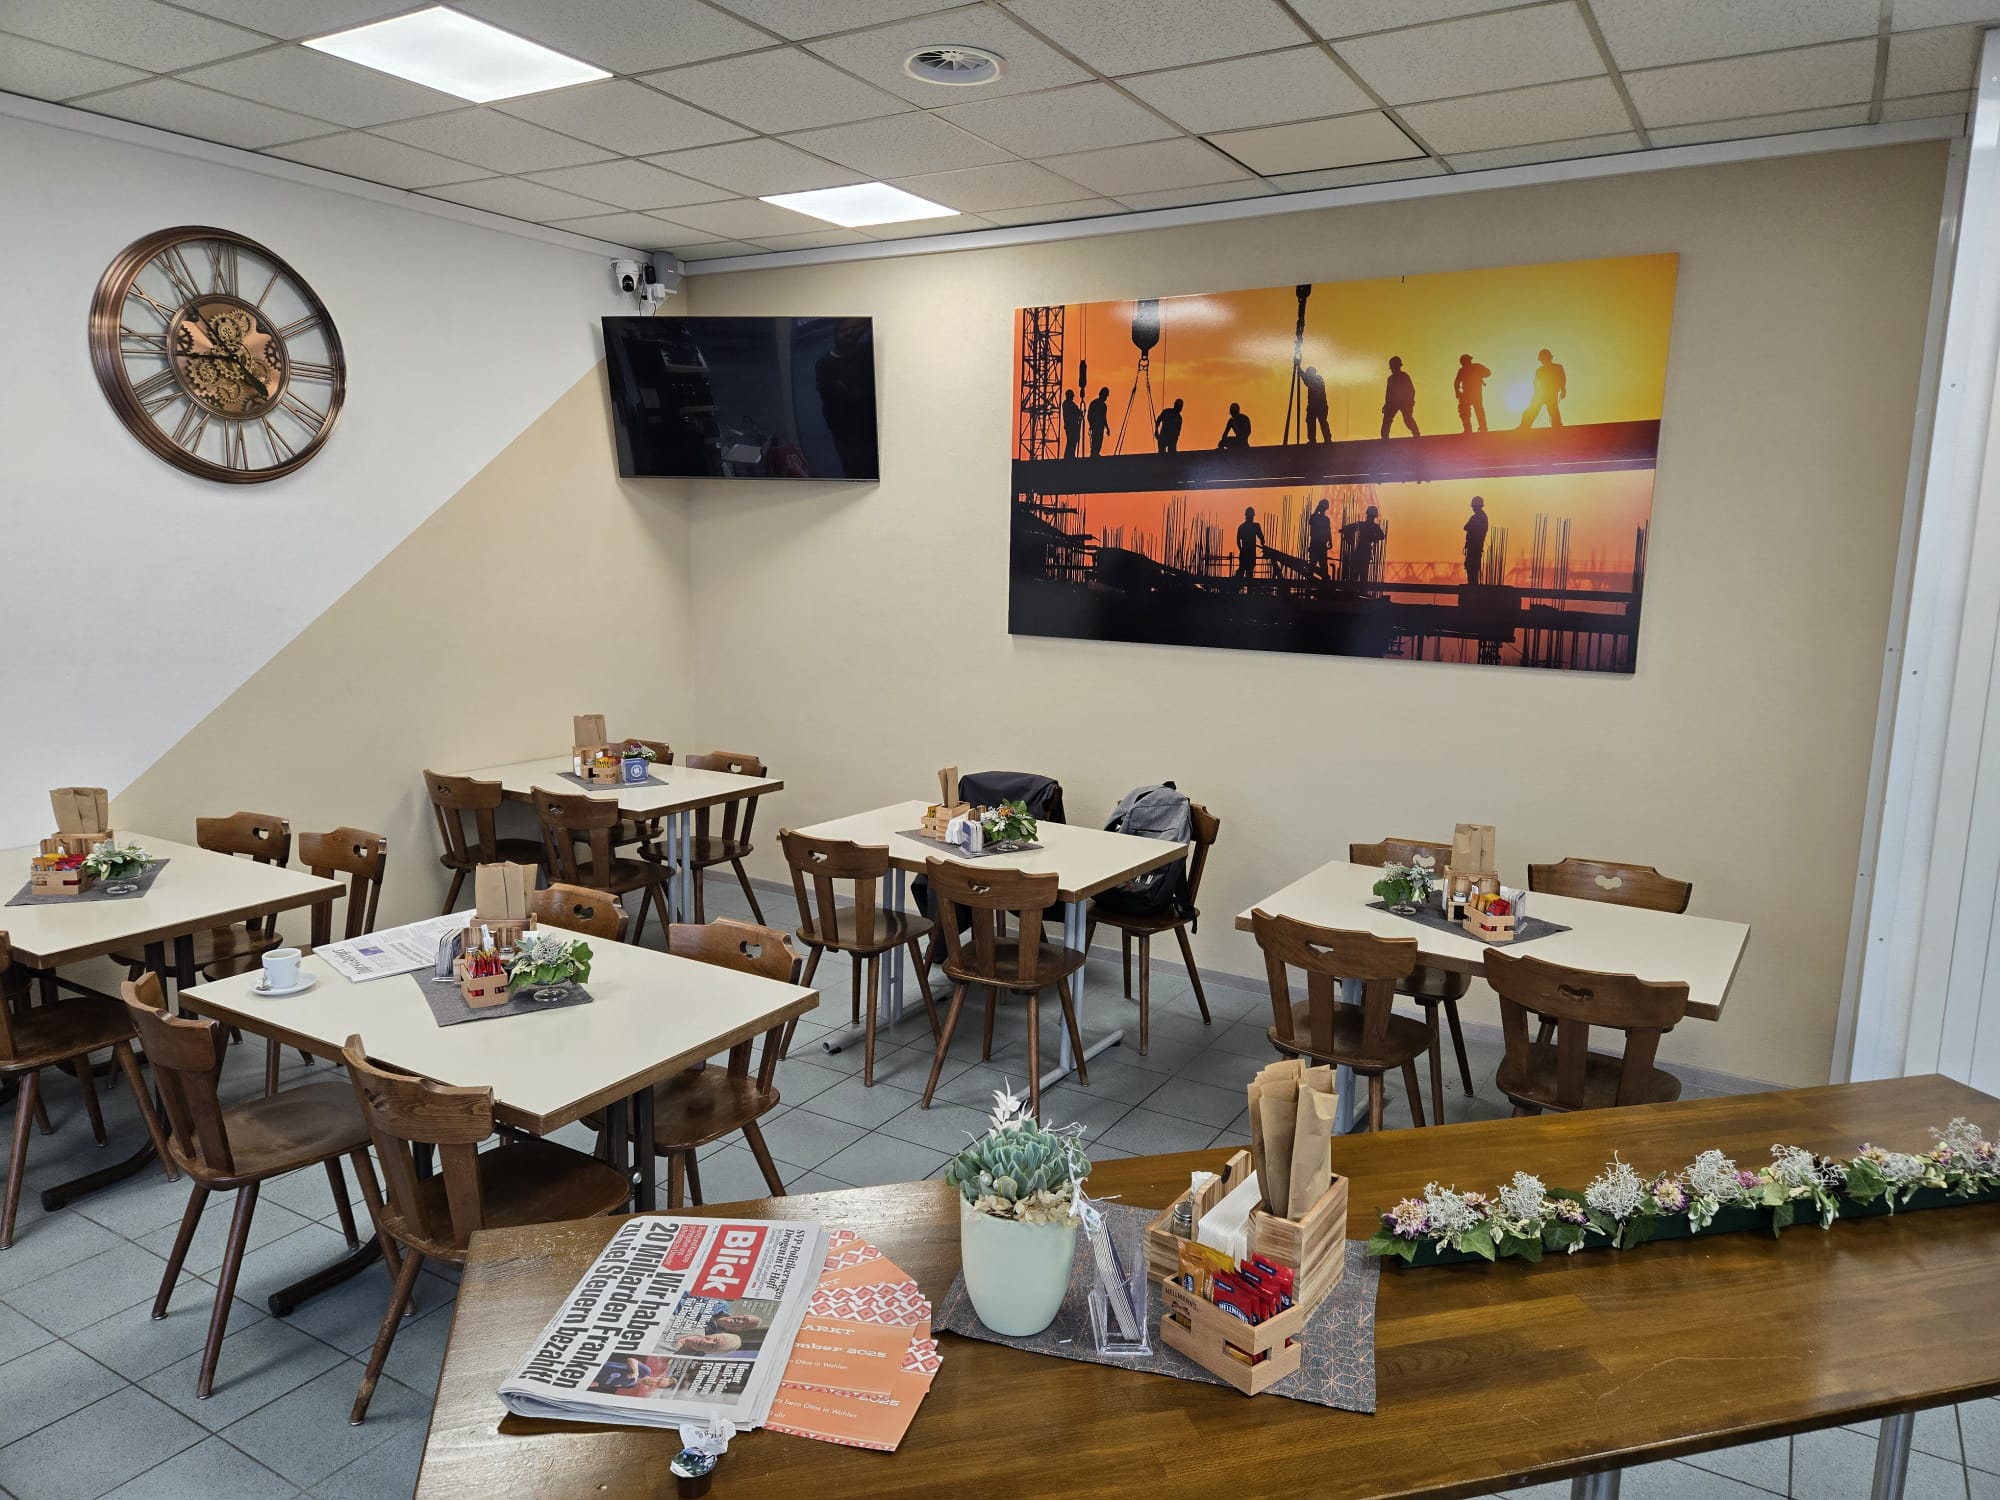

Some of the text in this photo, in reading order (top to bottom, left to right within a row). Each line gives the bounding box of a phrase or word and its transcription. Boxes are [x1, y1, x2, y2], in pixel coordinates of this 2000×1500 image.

[155, 245, 200, 303] XI
[208, 242, 238, 296] XII
[257, 269, 281, 309] I
[128, 282, 176, 323] X
[278, 313, 322, 340] II
[290, 359, 335, 380] III
[777, 1229, 794, 1254] Drogen
[701, 1230, 754, 1292] Blick
[771, 1229, 805, 1299] SVP-Politiker wegen
[641, 1271, 685, 1299] Wir
[763, 1264, 782, 1289] U-Haft
[516, 1222, 646, 1383] zu viel Steuern bezahlt!
[550, 1222, 680, 1389] 20 Milliarden Franken
[685, 1302, 706, 1320] Happy
[612, 1300, 671, 1352] haben
[667, 1306, 692, 1328] Ehepaar
[694, 1314, 712, 1328] Blick
[801, 1324, 855, 1335] ARKT
[663, 1328, 681, 1342] Jost
[795, 1342, 888, 1358] mber 2025
[731, 1362, 749, 1383] Neuer
[823, 1361, 848, 1370] Wohlen
[831, 1407, 857, 1418] Wohlen
